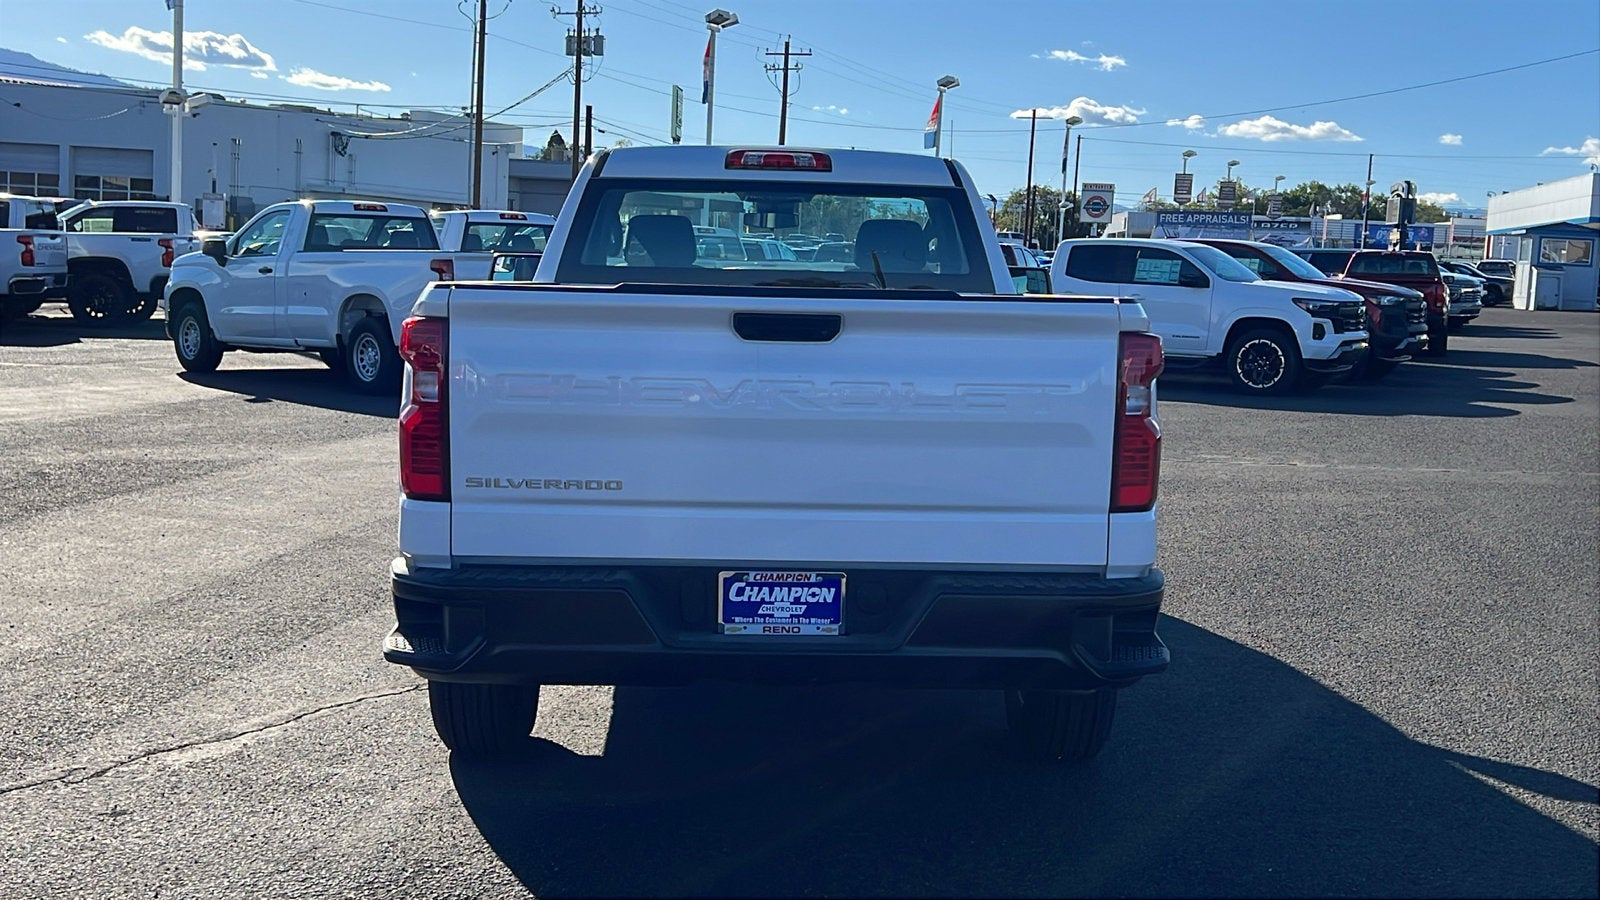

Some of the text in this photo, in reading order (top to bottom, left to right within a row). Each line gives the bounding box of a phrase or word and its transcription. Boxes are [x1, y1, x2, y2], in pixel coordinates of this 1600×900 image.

[1159, 213, 1249, 225] FREE APPRAISALS!
[496, 373, 1071, 414] CHEVROLET
[465, 477, 623, 491] SILVERADO
[753, 573, 812, 582] CHAMPION
[728, 581, 836, 603] CHAMPION
[762, 626, 801, 634] RENO
